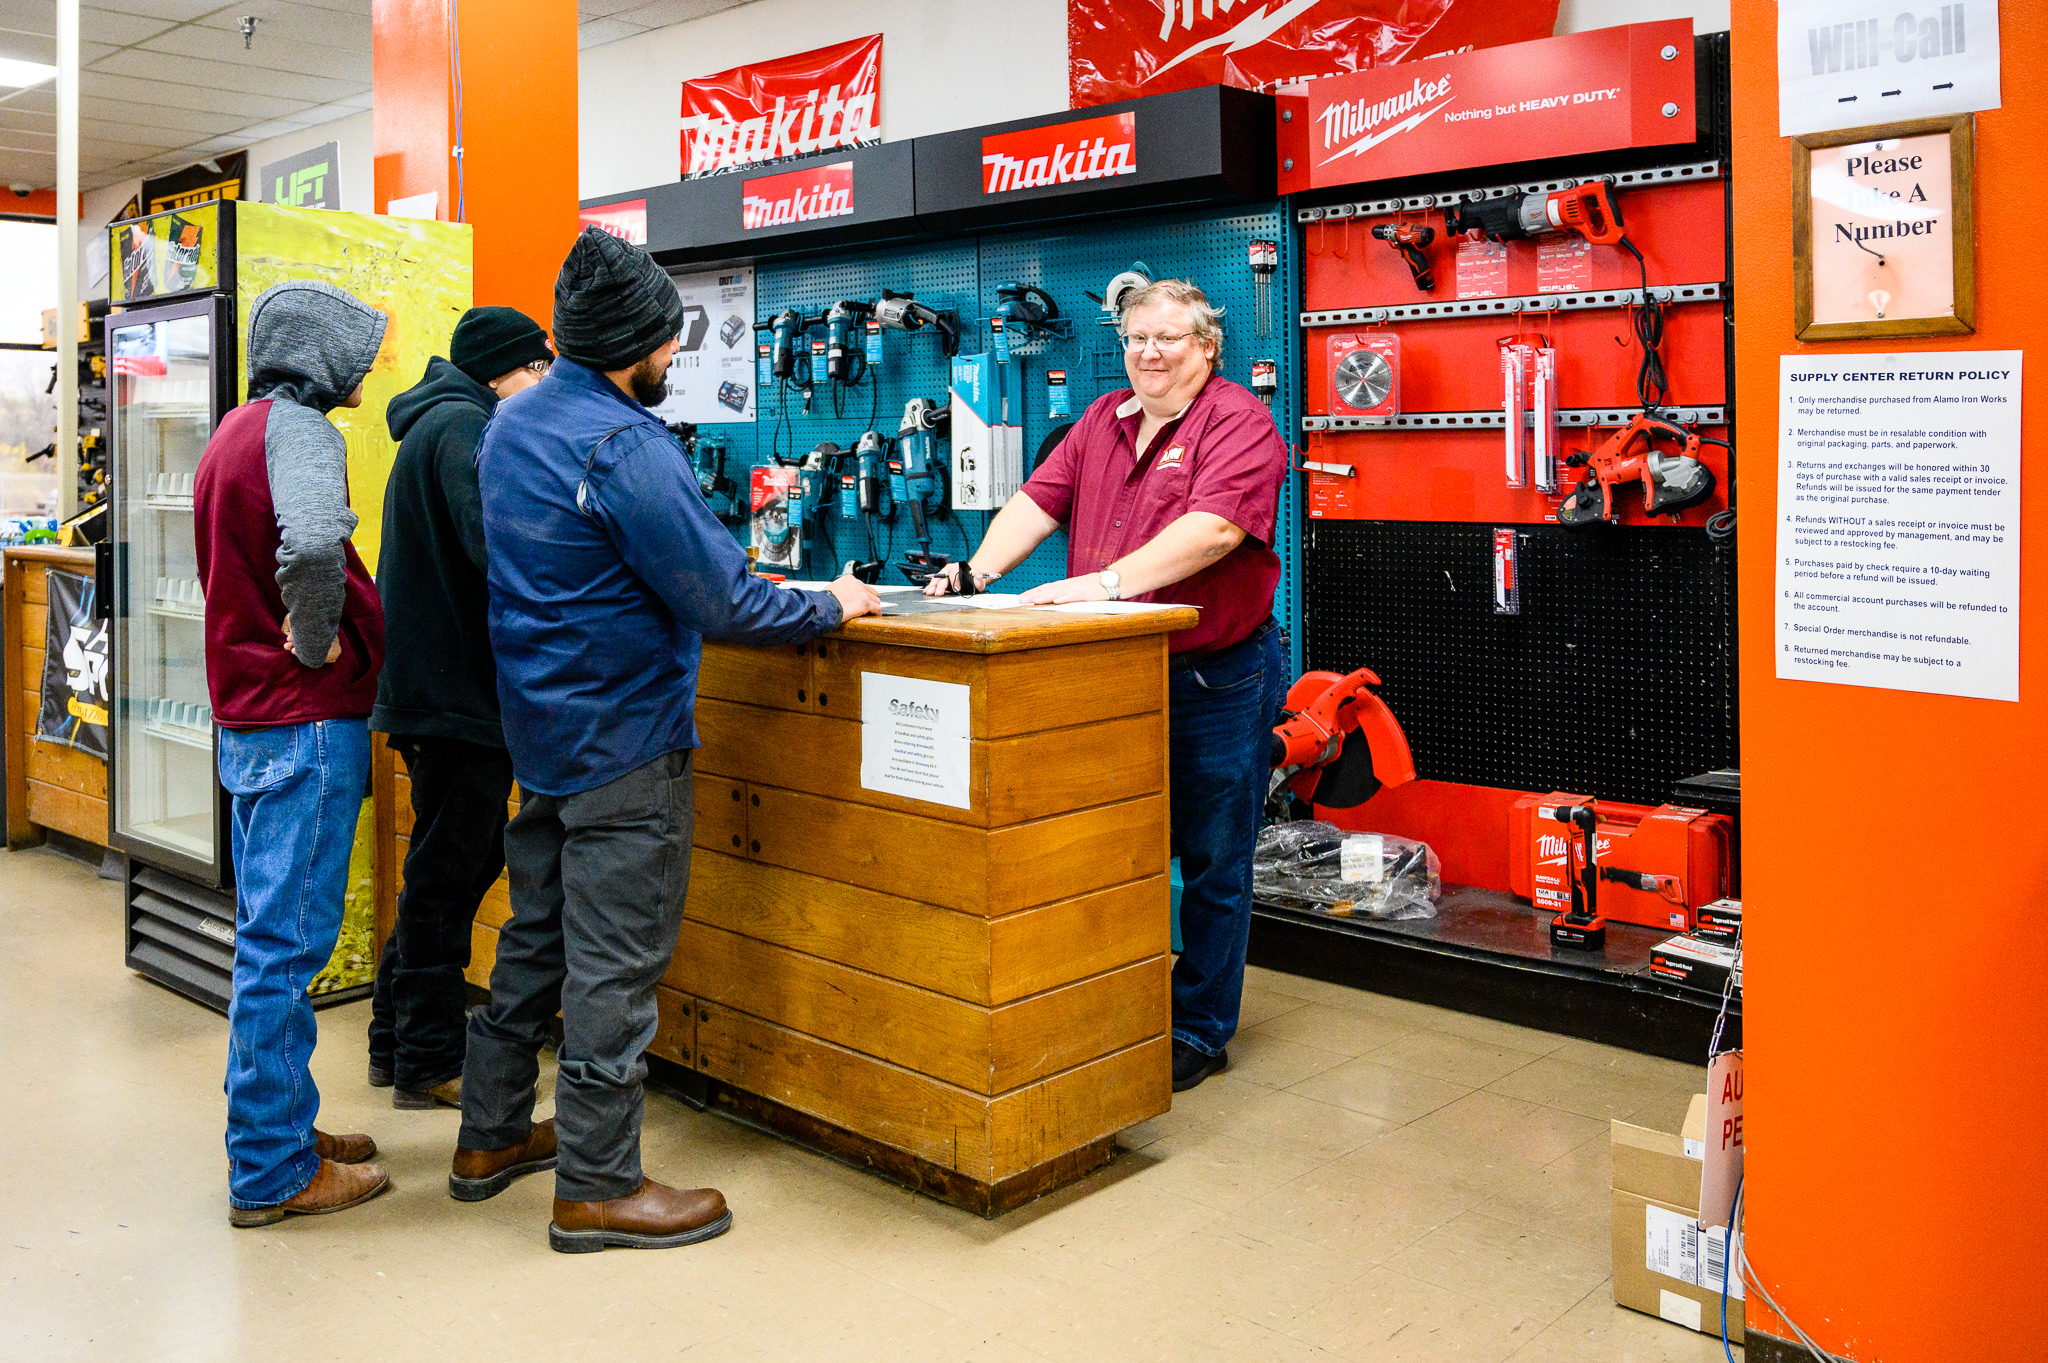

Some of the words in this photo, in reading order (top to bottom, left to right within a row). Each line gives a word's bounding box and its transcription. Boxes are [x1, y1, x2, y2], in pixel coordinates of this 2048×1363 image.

[1808, 3, 1965, 75] Will-Call
[1315, 75, 1451, 149] Milwaukee
[1444, 107, 1492, 122] Nothing
[1495, 103, 1516, 116] but
[1519, 95, 1570, 112] HEAVY
[1846, 156, 1922, 177] Please
[1908, 182, 1927, 203] A
[1835, 218, 1937, 243] Number
[1790, 373, 1839, 382] SUPPLY
[1842, 372, 1895, 382] CENTER
[1899, 371, 1954, 381] RETURN
[1958, 370, 2010, 380] POLICY
[1798, 396, 1816, 405] Only
[1817, 396, 1867, 404] merchandise
[1869, 396, 1911, 405] purchased
[1912, 395, 1932, 403] from
[1933, 395, 1960, 403] Alamo
[1961, 395, 1978, 403] Iron
[1980, 395, 2008, 403] Works
[1798, 408, 1814, 416] may
[1788, 428, 1794, 436] 2.
[1797, 428, 1846, 436] Merchandise
[1890, 429, 1927, 437] resalable
[1928, 430, 1967, 438] condition
[1969, 430, 1987, 438] with
[1797, 440, 1826, 448] original
[1827, 440, 1869, 450] packaging,
[1871, 441, 1894, 449] parts,
[1895, 440, 1911, 448] and
[1912, 441, 1958, 450] paperwork.
[1796, 461, 1826, 469] Returns
[1844, 463, 1886, 472] exchanges
[1904, 463, 1914, 471] be
[1916, 464, 1950, 472] honored
[1952, 464, 1978, 472] within
[1979, 464, 1990, 472] 30
[1796, 472, 1814, 481] days
[1816, 472, 1824, 480] of
[1825, 473, 1862, 481] purchase
[1888, 474, 1908, 482] valid
[1909, 475, 1931, 483] sales
[1933, 476, 1962, 485] receipt
[1974, 476, 2008, 485] invoice.
[1796, 482, 1828, 491] Refunds
[1844, 484, 1854, 492] be
[1883, 485, 1895, 493] for
[1897, 486, 1910, 494] the
[1935, 488, 1972, 496] payment
[1973, 488, 2001, 496] tender
[1806, 494, 1818, 502] the
[1820, 495, 1849, 504] original
[1851, 496, 1890, 504] purchase.
[1795, 515, 1827, 524] Refunds
[1828, 516, 1866, 525] WITHOUT
[1897, 520, 1926, 529] receipt
[1938, 521, 1969, 530] invoice
[1970, 523, 1992, 531] must
[1994, 523, 2005, 531] be
[1794, 538, 1822, 546] subject
[1840, 540, 1882, 550] restocking
[1883, 541, 1898, 549] fee.
[1846, 530, 1884, 538] approved
[1885, 530, 1896, 540] by
[1897, 532, 1953, 541] management,
[1972, 535, 1991, 544] may
[1992, 534, 2004, 543] be
[1794, 558, 1834, 568] Purchases
[1854, 562, 1864, 572] by
[1866, 563, 1890, 571] check
[1891, 565, 1921, 574] require
[1930, 566, 1958, 577] 10-day
[1959, 568, 1990, 579] waiting
[1820, 571, 1845, 580] before
[1853, 573, 1879, 582] refund
[1896, 575, 1906, 584] be
[1908, 576, 1938, 585] issued.
[1784, 590, 1790, 598] 6.
[1805, 594, 1850, 602] commercial
[1852, 596, 1884, 604] account
[1885, 599, 1928, 608] purchases
[1929, 600, 1944, 608] will
[1946, 601, 1957, 610] be
[1958, 603, 1997, 612] refunded
[1999, 605, 2008, 613] to
[1793, 602, 1806, 610] the
[1807, 604, 1840, 612] account.
[1784, 622, 1791, 630] 7.
[1793, 624, 1821, 632] Special
[1823, 626, 1845, 635] Order
[1847, 629, 1898, 639] merchandise
[1900, 632, 1907, 640] is
[1924, 634, 1971, 645] refundable.
[1784, 644, 1791, 652] 8.
[1794, 645, 1829, 655] Returned
[1830, 650, 1881, 660] merchandise
[1883, 654, 1900, 663] may
[1901, 654, 1912, 663] be
[1913, 656, 1944, 666] subject
[1794, 657, 1834, 668] restocking
[1836, 659, 1850, 668] fee.
[888, 698, 940, 721] Safety
